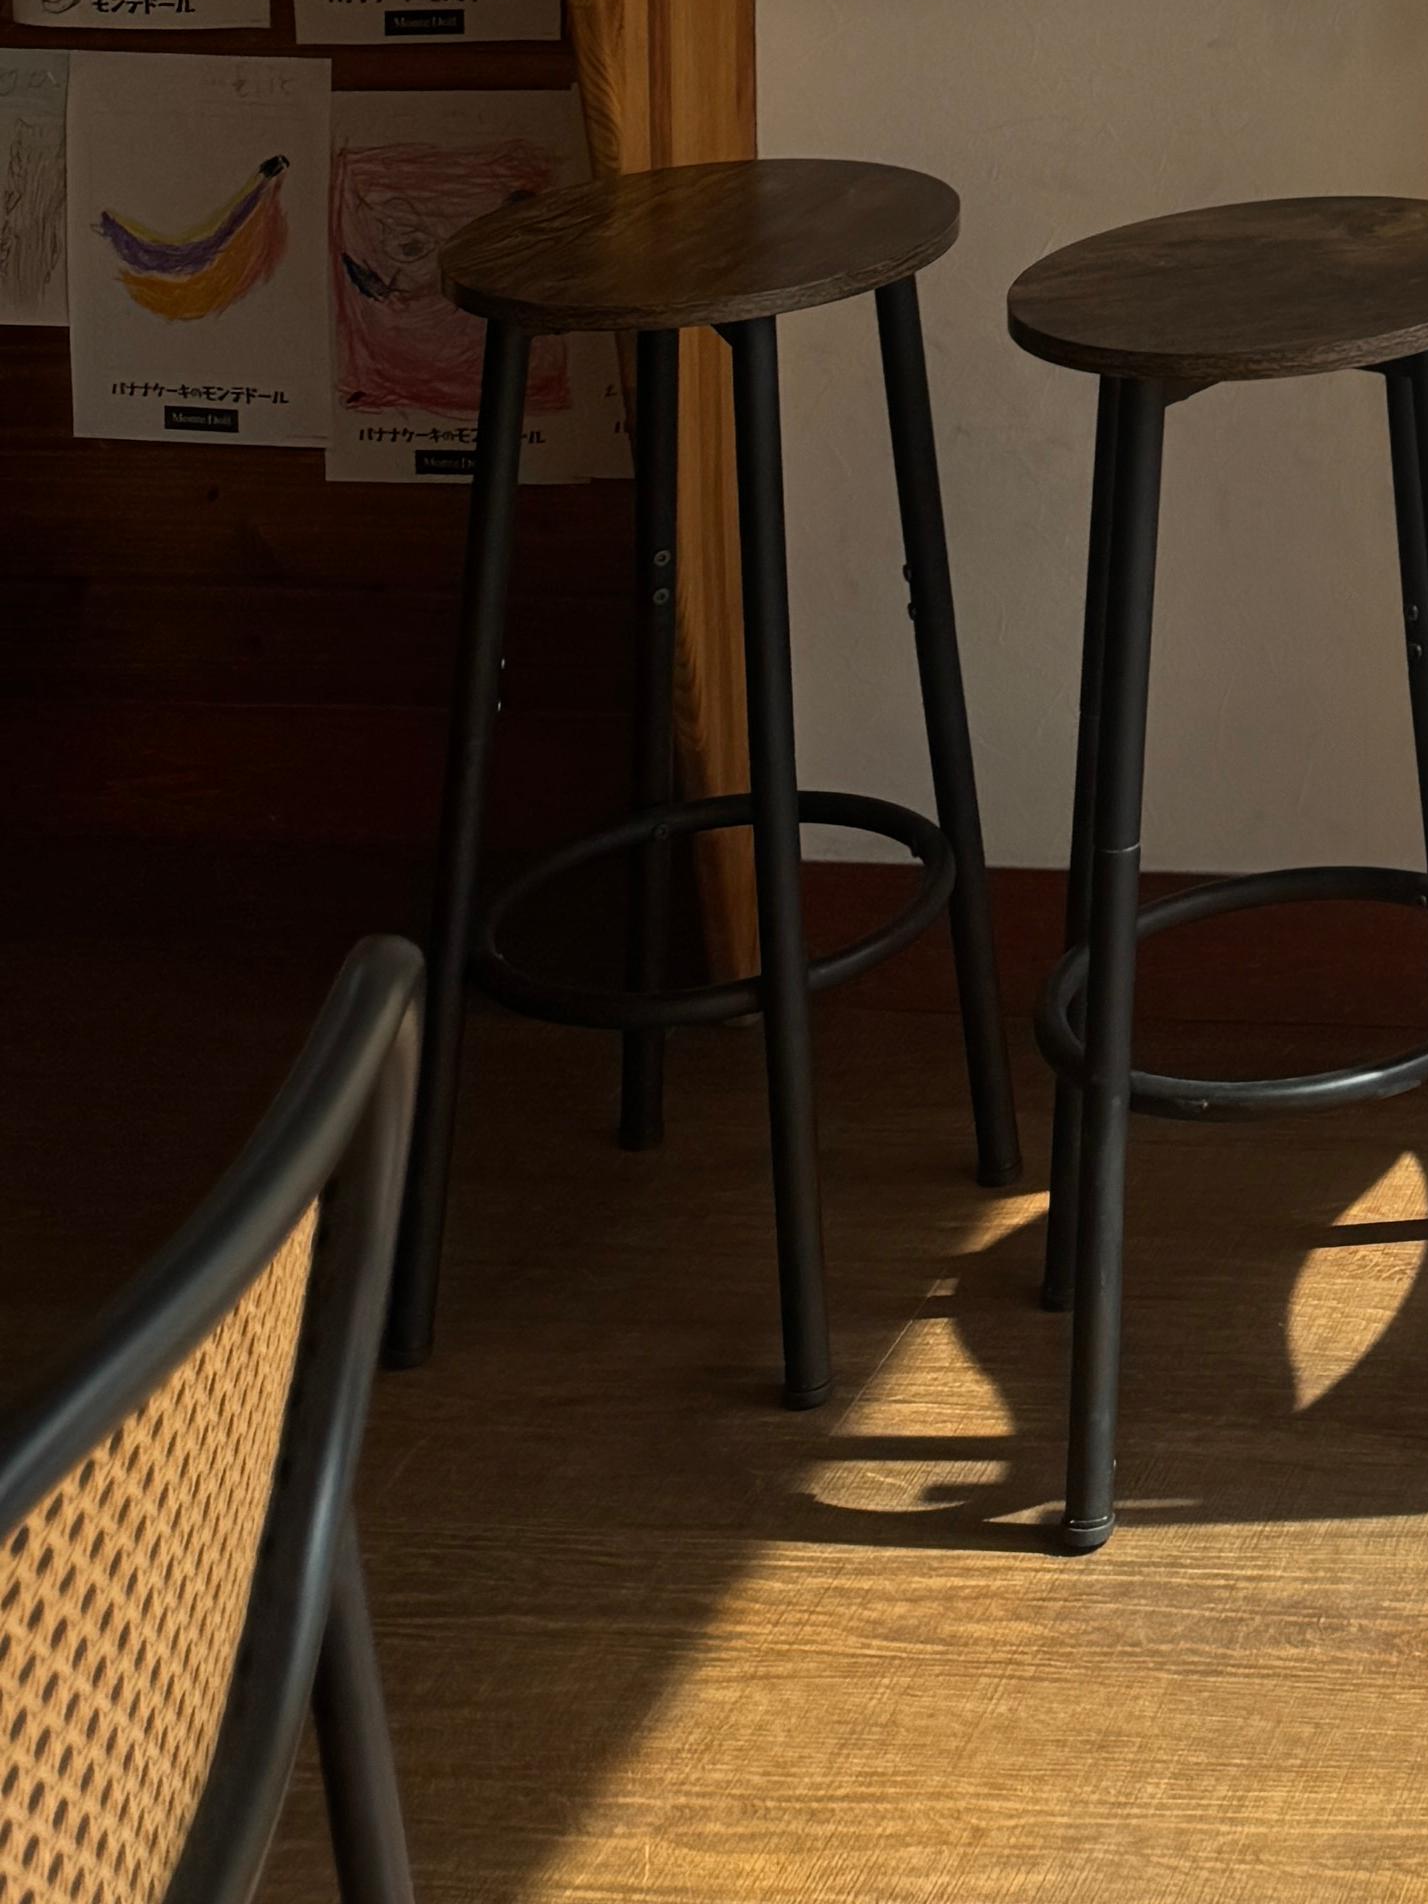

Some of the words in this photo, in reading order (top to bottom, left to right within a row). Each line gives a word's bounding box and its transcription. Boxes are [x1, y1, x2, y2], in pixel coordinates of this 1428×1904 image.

[111, 381, 289, 404] バナナケーキのモンテドール
